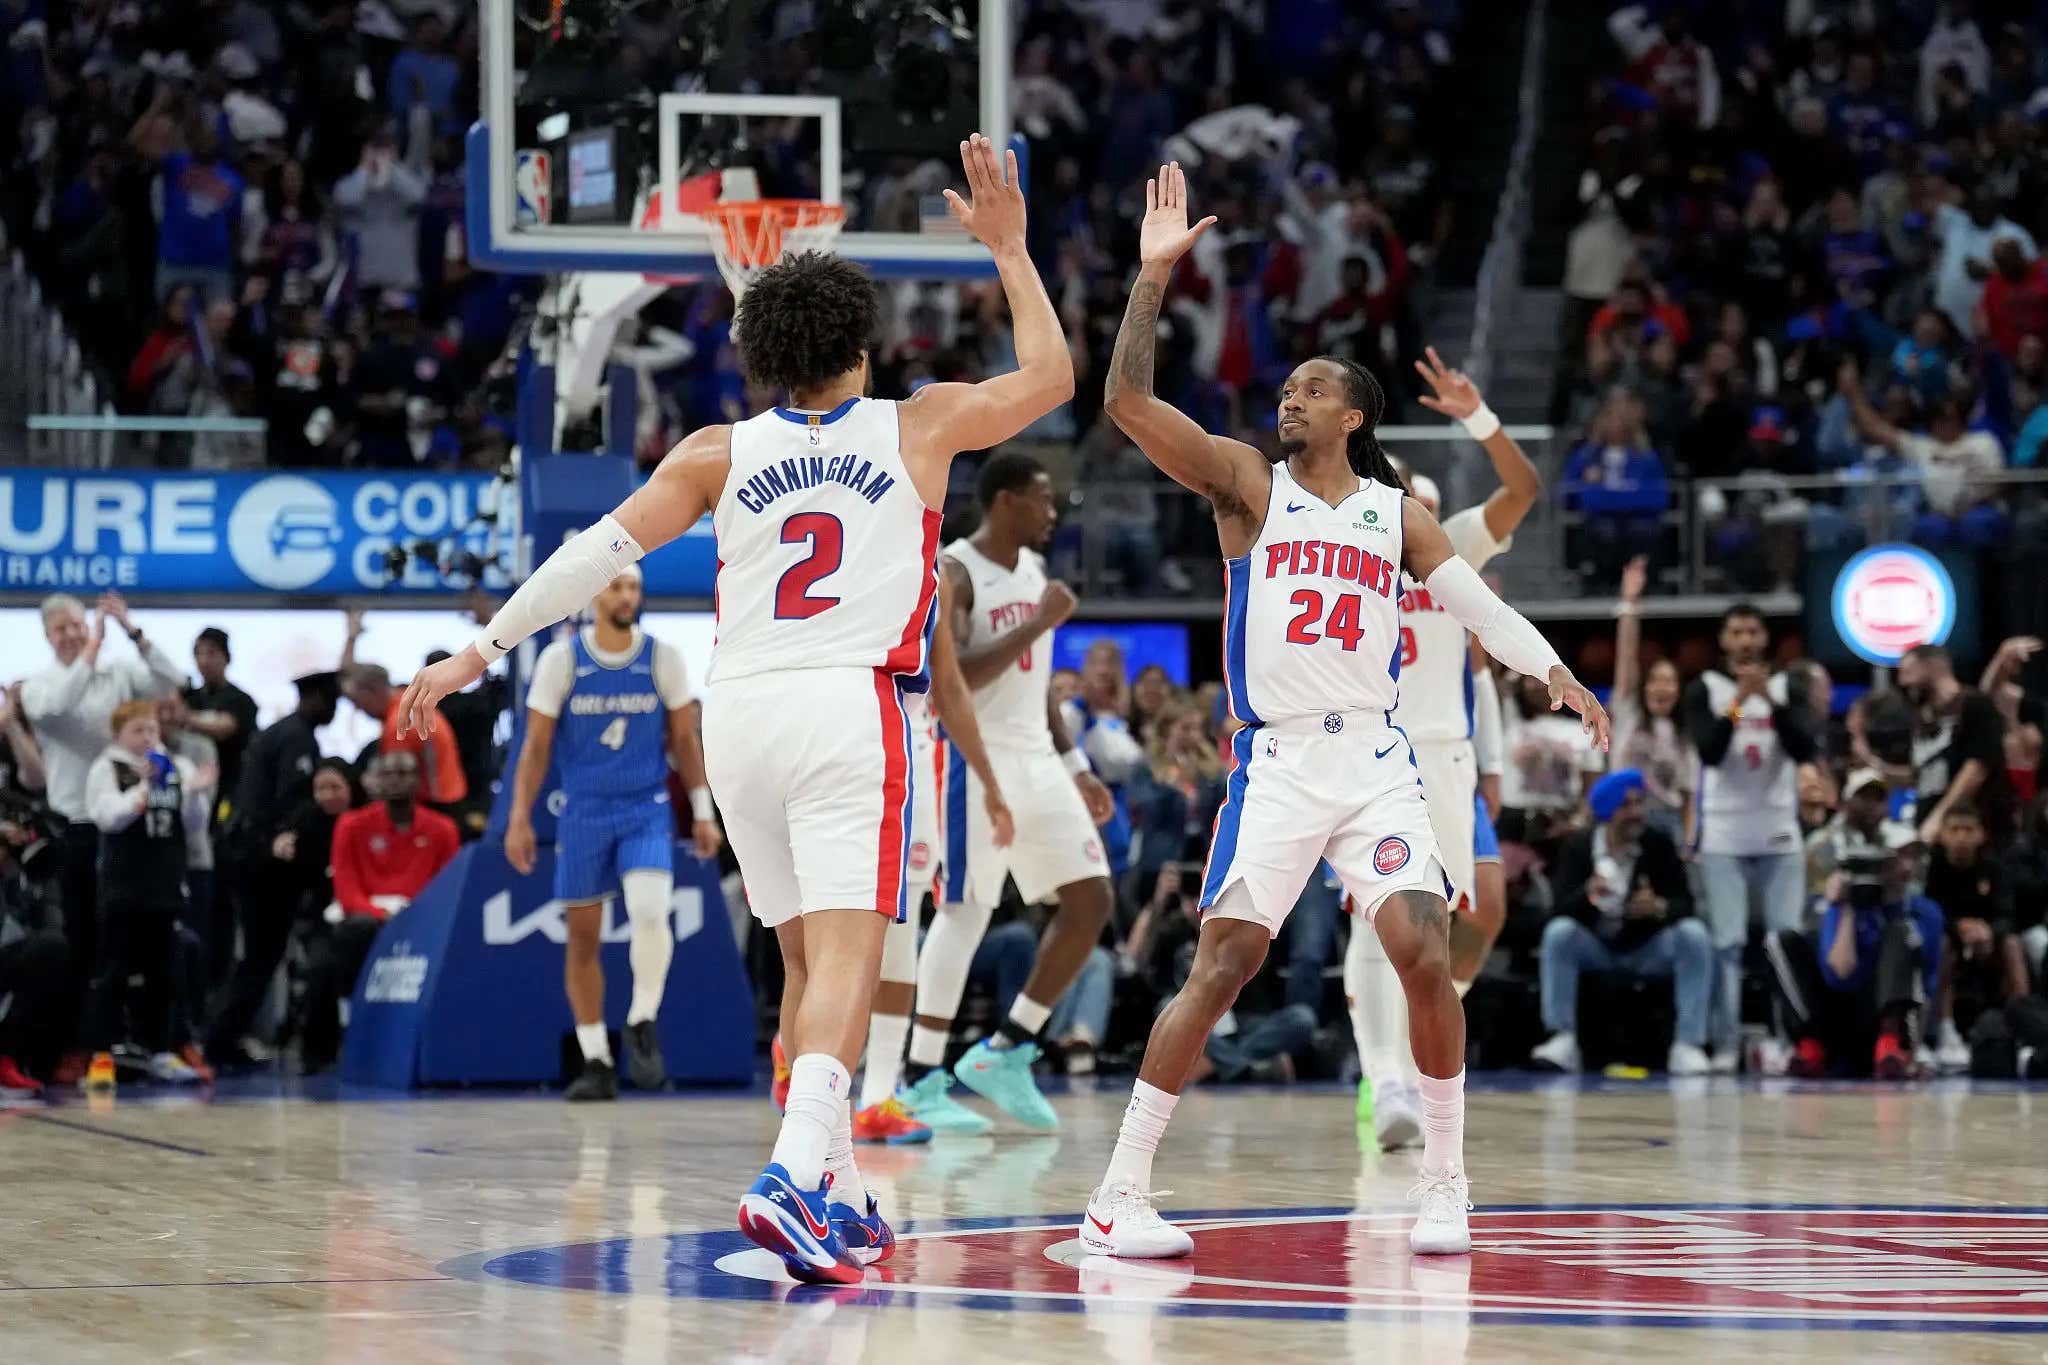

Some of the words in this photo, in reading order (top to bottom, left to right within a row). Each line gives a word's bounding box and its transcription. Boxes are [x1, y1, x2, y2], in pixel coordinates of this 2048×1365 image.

[736, 454, 895, 515] CUNNINGHAM
[773, 511, 844, 620] 2
[1265, 540, 1395, 599] PISTONS
[1286, 589, 1365, 652] 24
[600, 716, 628, 751] 4
